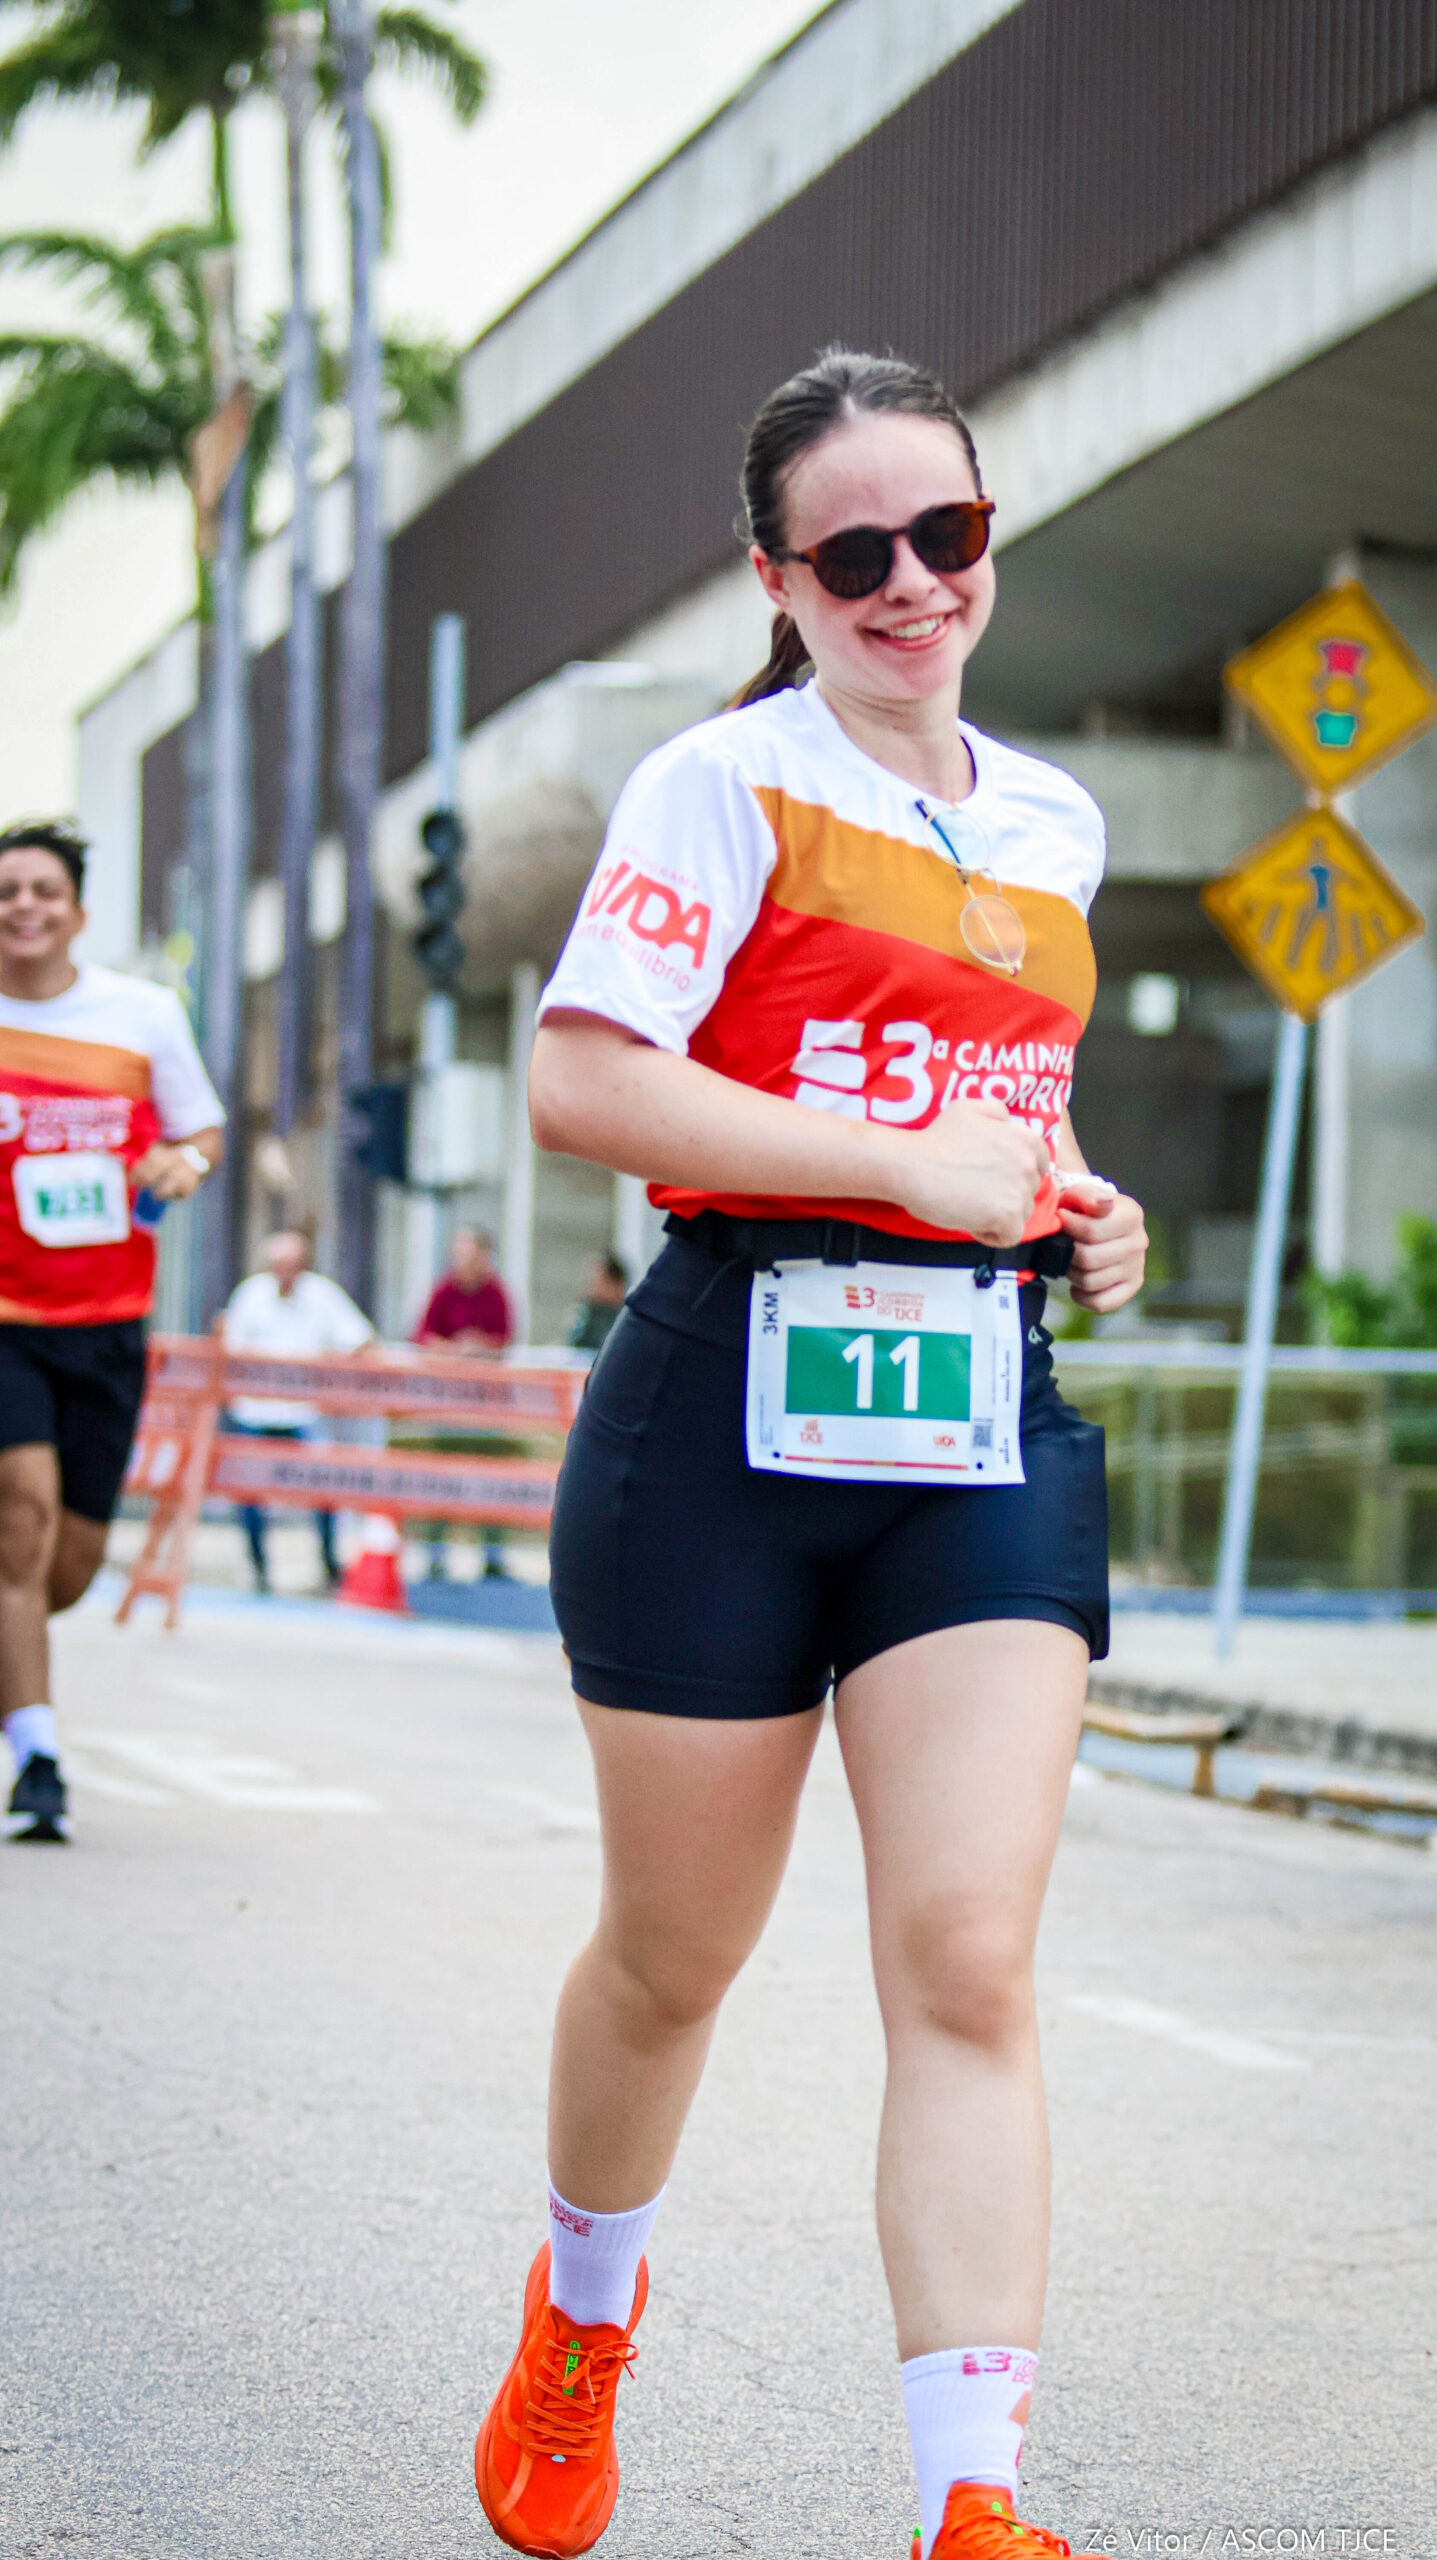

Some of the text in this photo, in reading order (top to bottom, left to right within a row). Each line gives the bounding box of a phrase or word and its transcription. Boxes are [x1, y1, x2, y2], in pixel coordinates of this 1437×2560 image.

[586, 860, 712, 971] VIDA
[955, 1039, 1074, 1076] CAMINH
[762, 1291, 779, 1335] 3KM
[841, 1333, 920, 1412] 11
